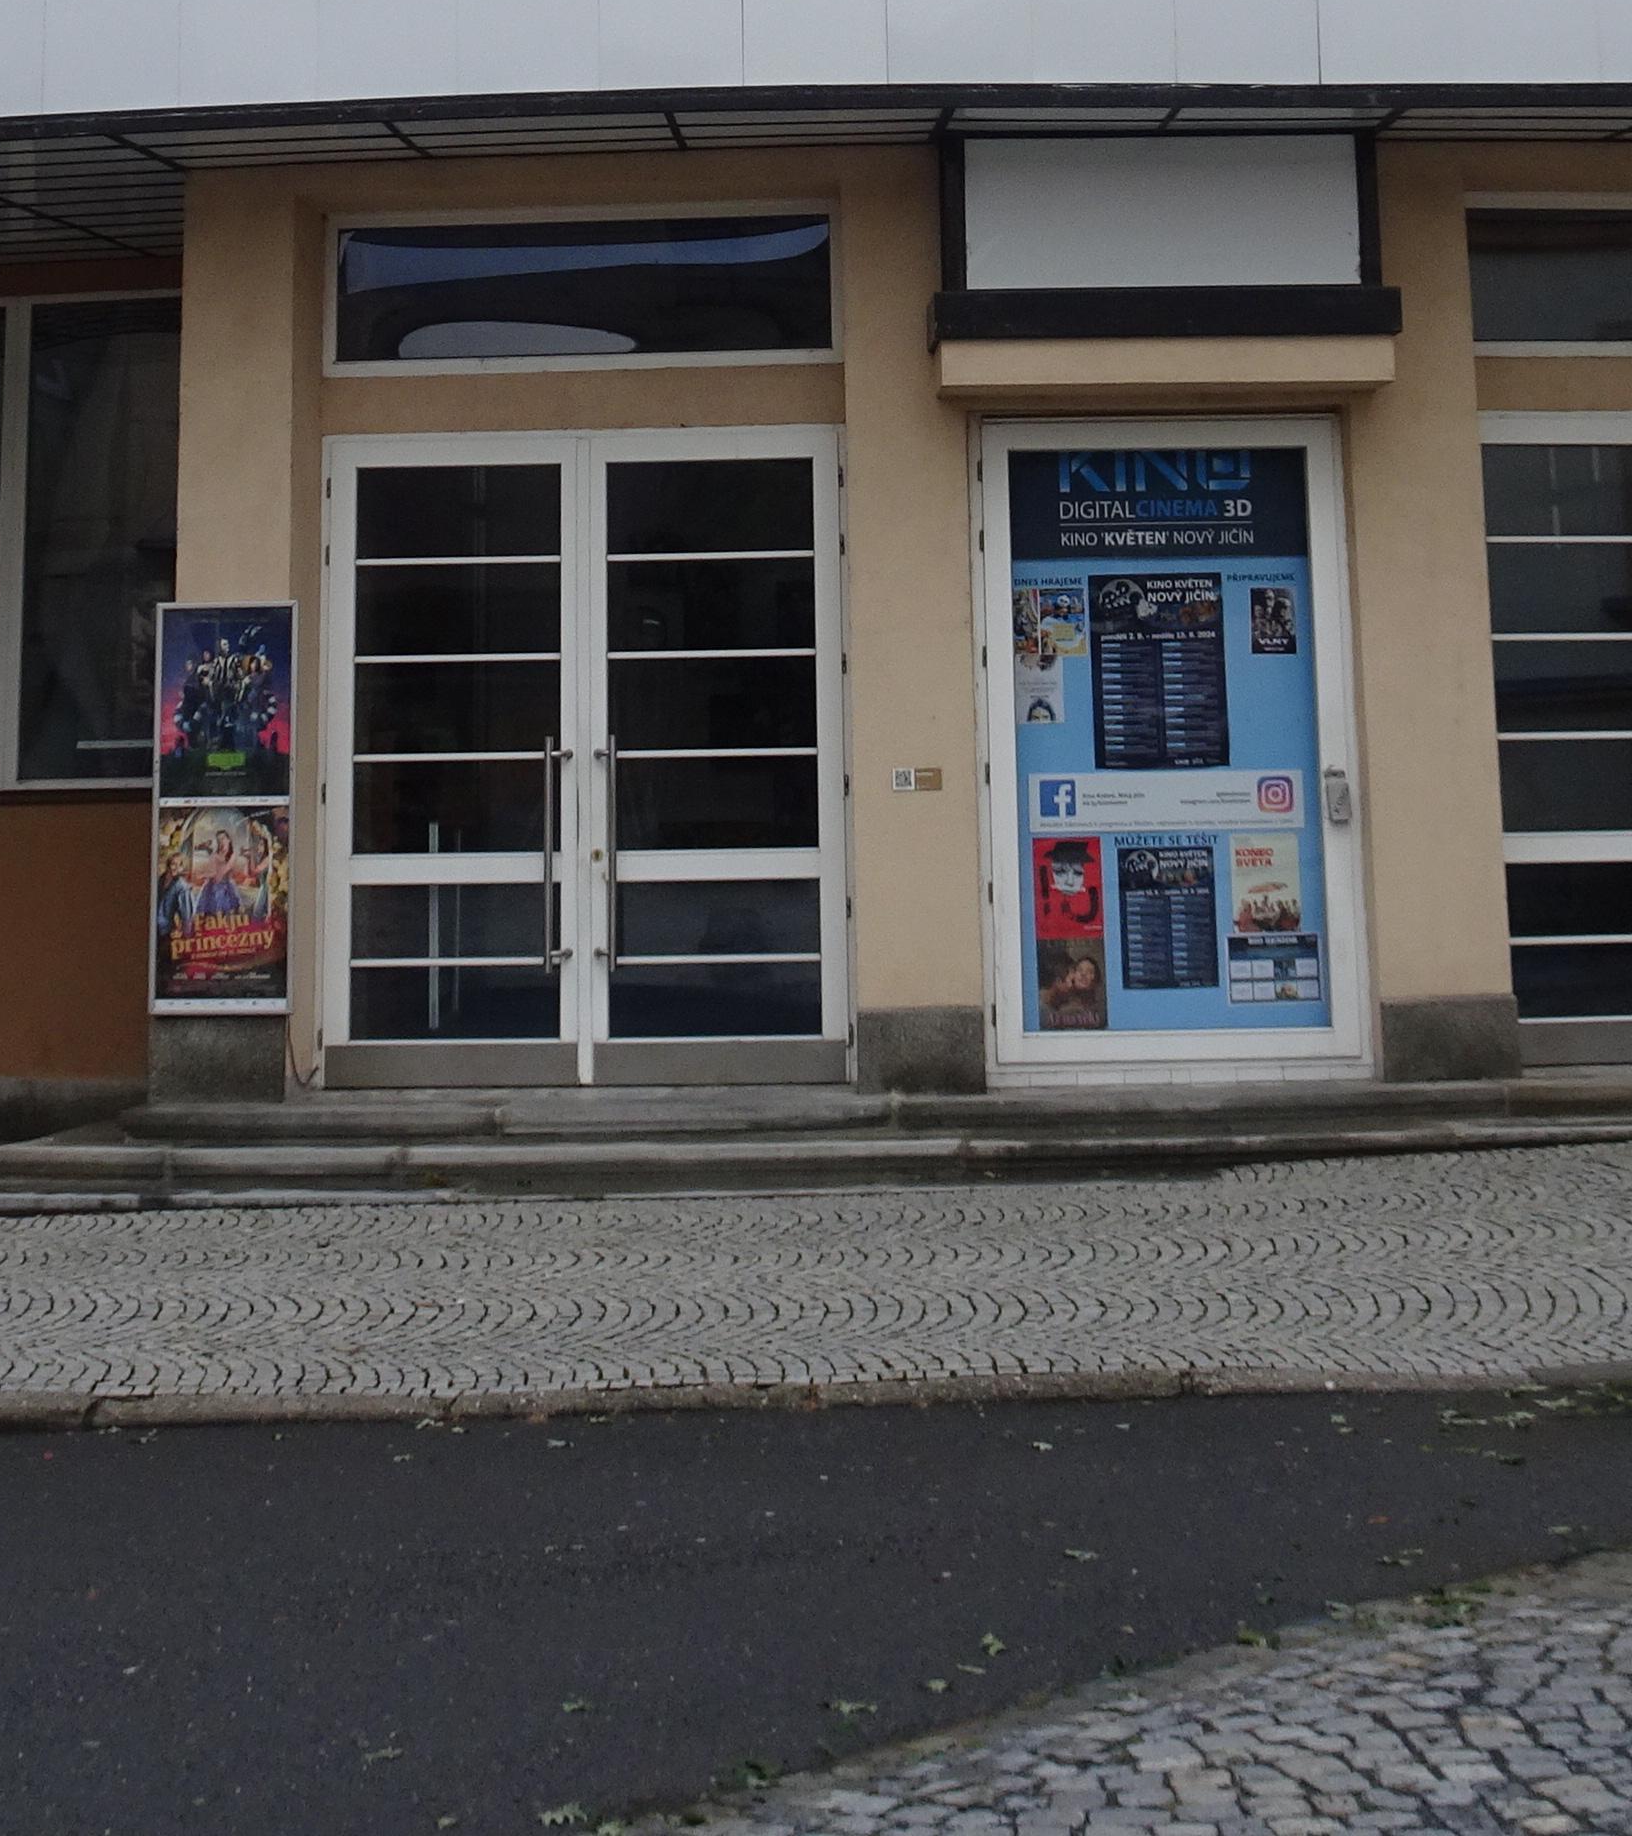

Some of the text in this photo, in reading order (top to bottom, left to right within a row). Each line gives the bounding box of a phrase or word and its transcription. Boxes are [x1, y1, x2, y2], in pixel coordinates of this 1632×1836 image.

[1223, 499, 1253, 518] 3D
[1060, 531, 1099, 547] KINO
[1172, 530, 1216, 545] NOVÝ
[1216, 527, 1255, 545] JIČÍN
[1146, 577, 1214, 589] KINO KVĚTEN
[1147, 589, 1216, 604] NOVÝ JIČÍN
[1167, 835, 1183, 846] SE
[170, 930, 275, 960] princezny
